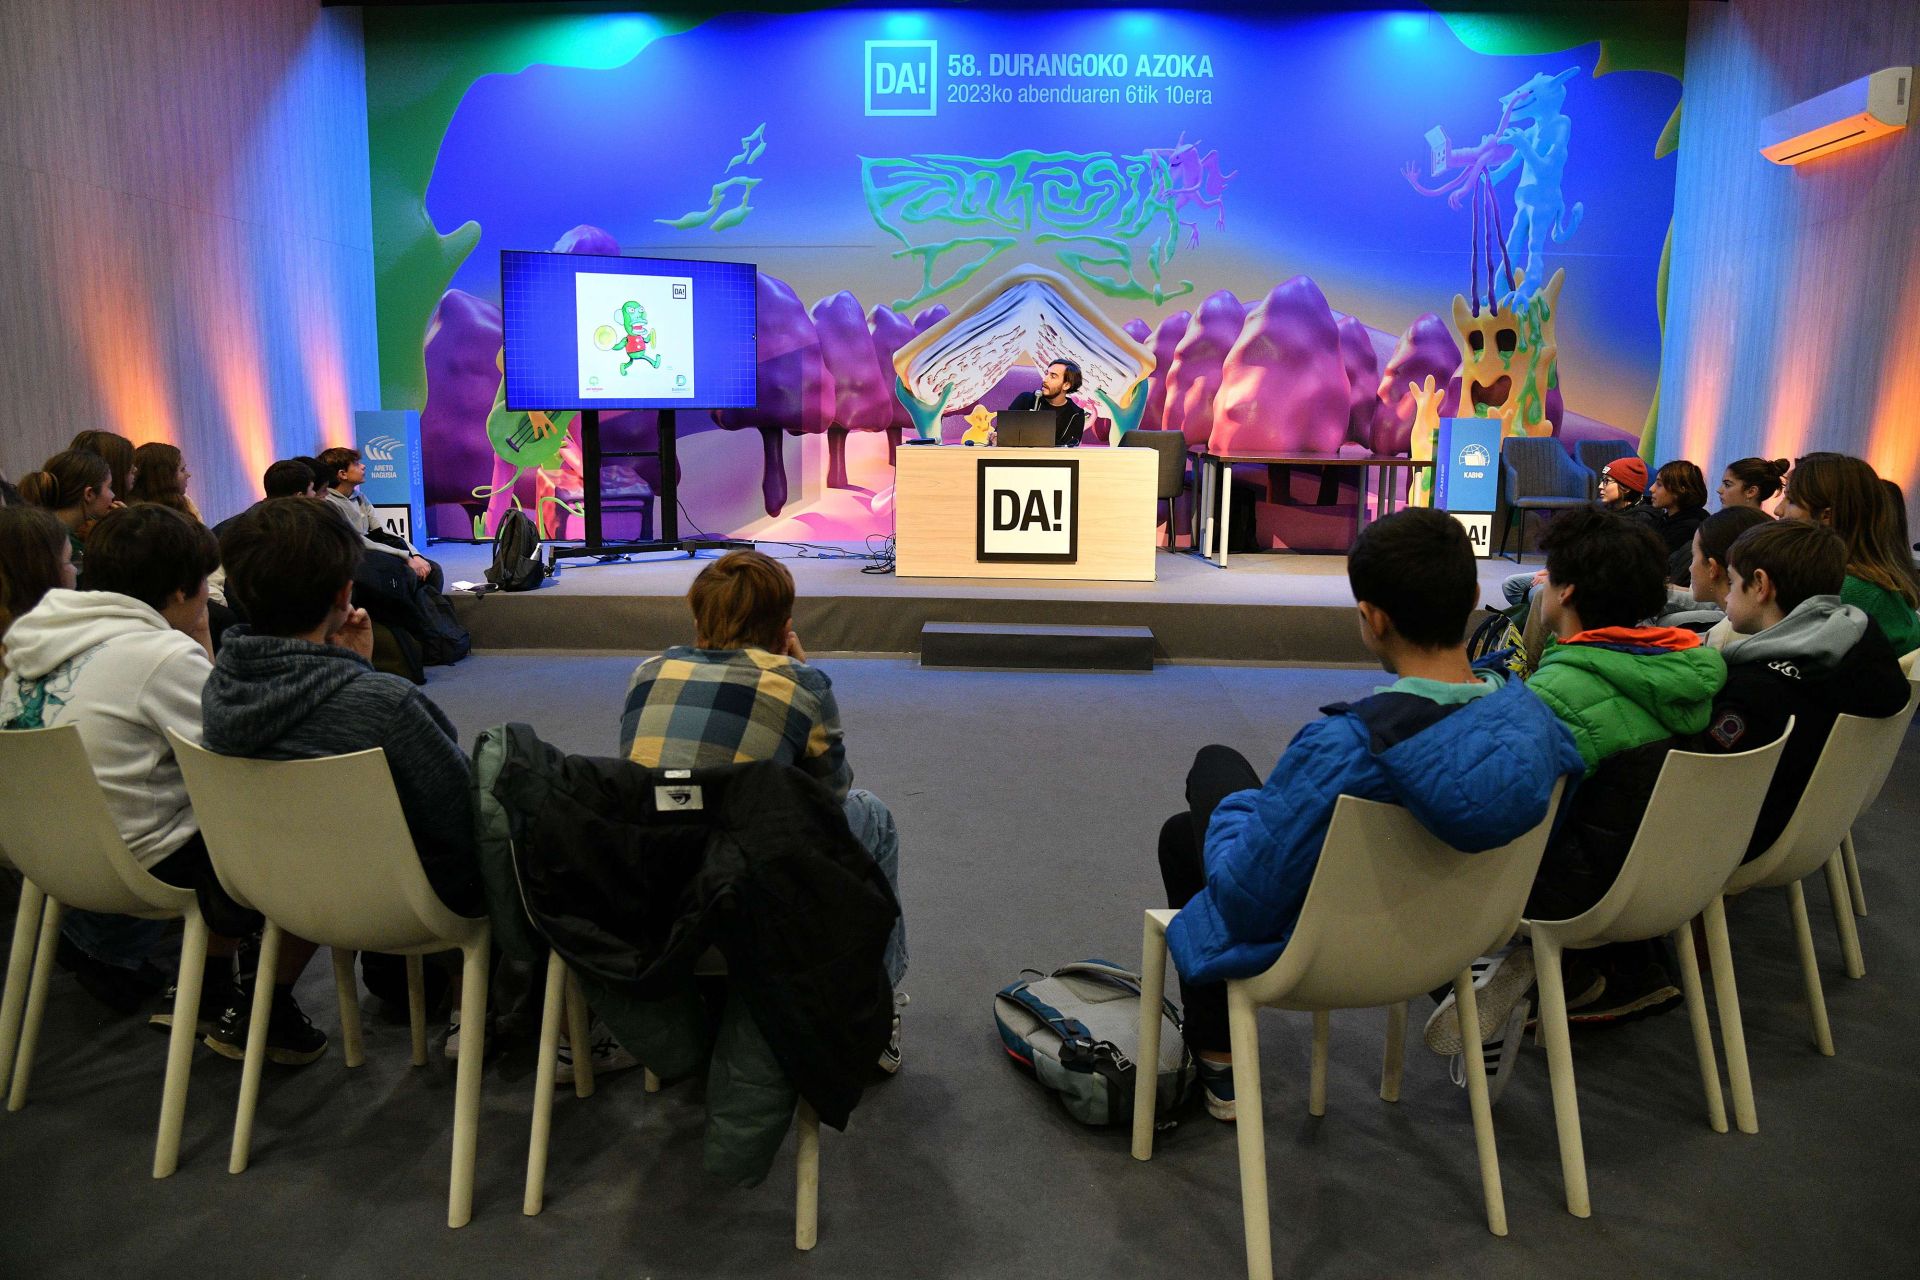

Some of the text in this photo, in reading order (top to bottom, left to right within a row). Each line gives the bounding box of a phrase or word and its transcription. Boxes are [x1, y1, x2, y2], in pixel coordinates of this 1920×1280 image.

[947, 53, 1215, 78] 58. DURANGOKO AZOKA
[875, 62, 926, 95] DA!
[947, 83, 1213, 105] 2023ko abenduaren 6tik 10era
[371, 471, 397, 479] NAGUSIA
[992, 489, 1063, 532] DA!
[1467, 524, 1487, 546] A!
